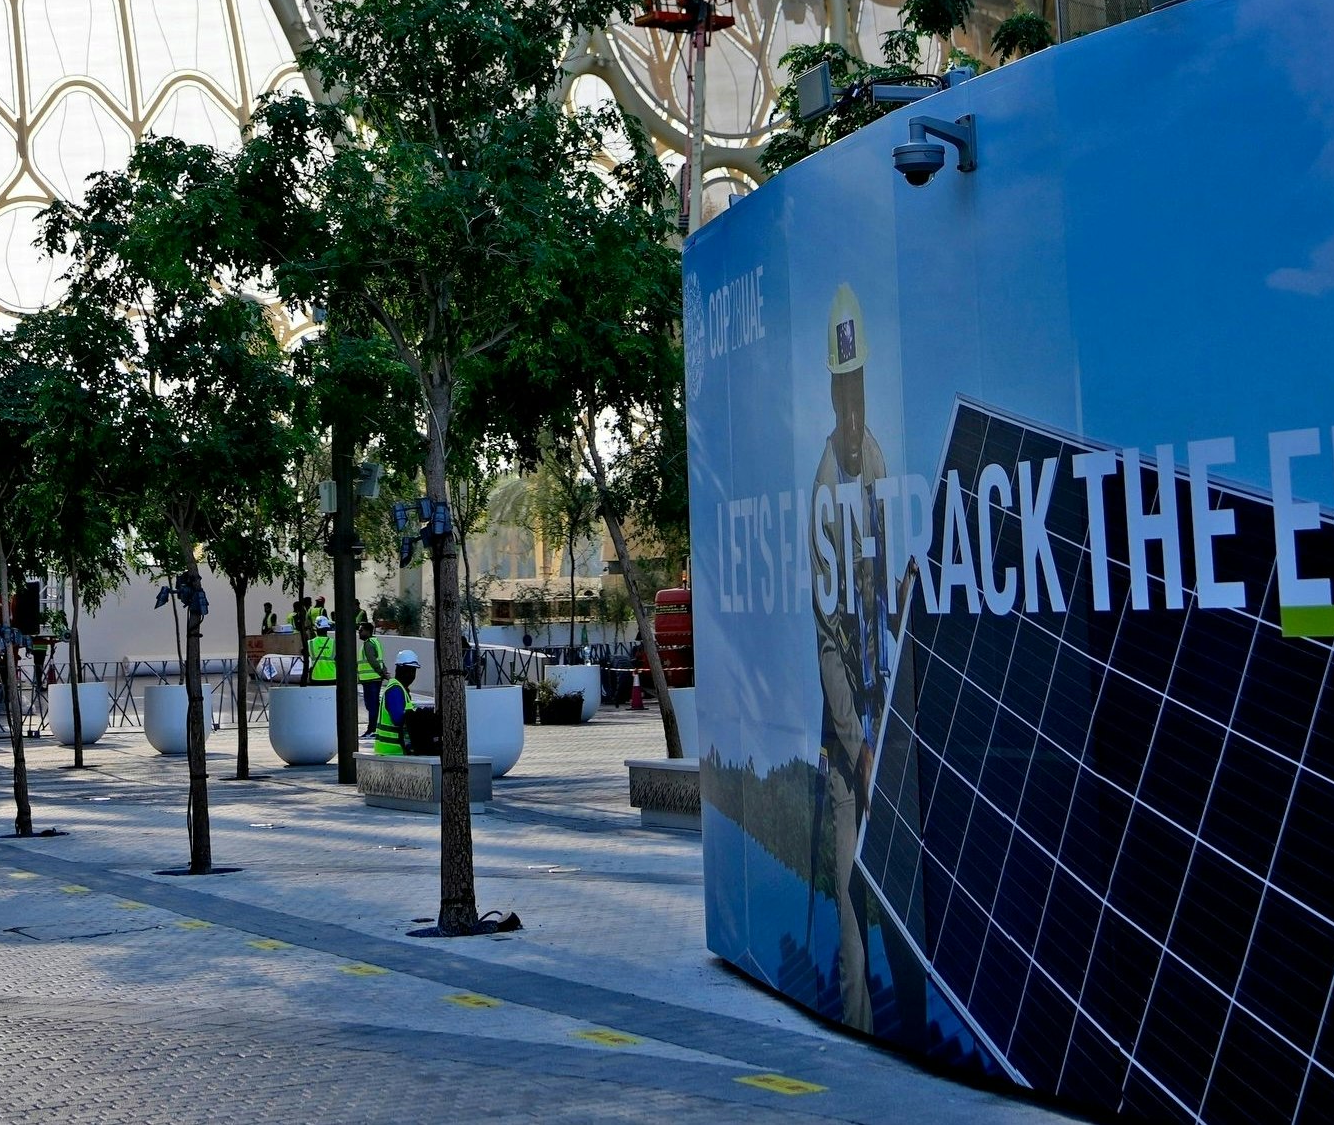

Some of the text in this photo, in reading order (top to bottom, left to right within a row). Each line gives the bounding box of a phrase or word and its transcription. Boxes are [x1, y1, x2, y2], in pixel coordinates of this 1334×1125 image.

[717, 492, 775, 616] LET'S
[778, 456, 1067, 617] FAST-TRACK
[1072, 436, 1247, 612] THE
